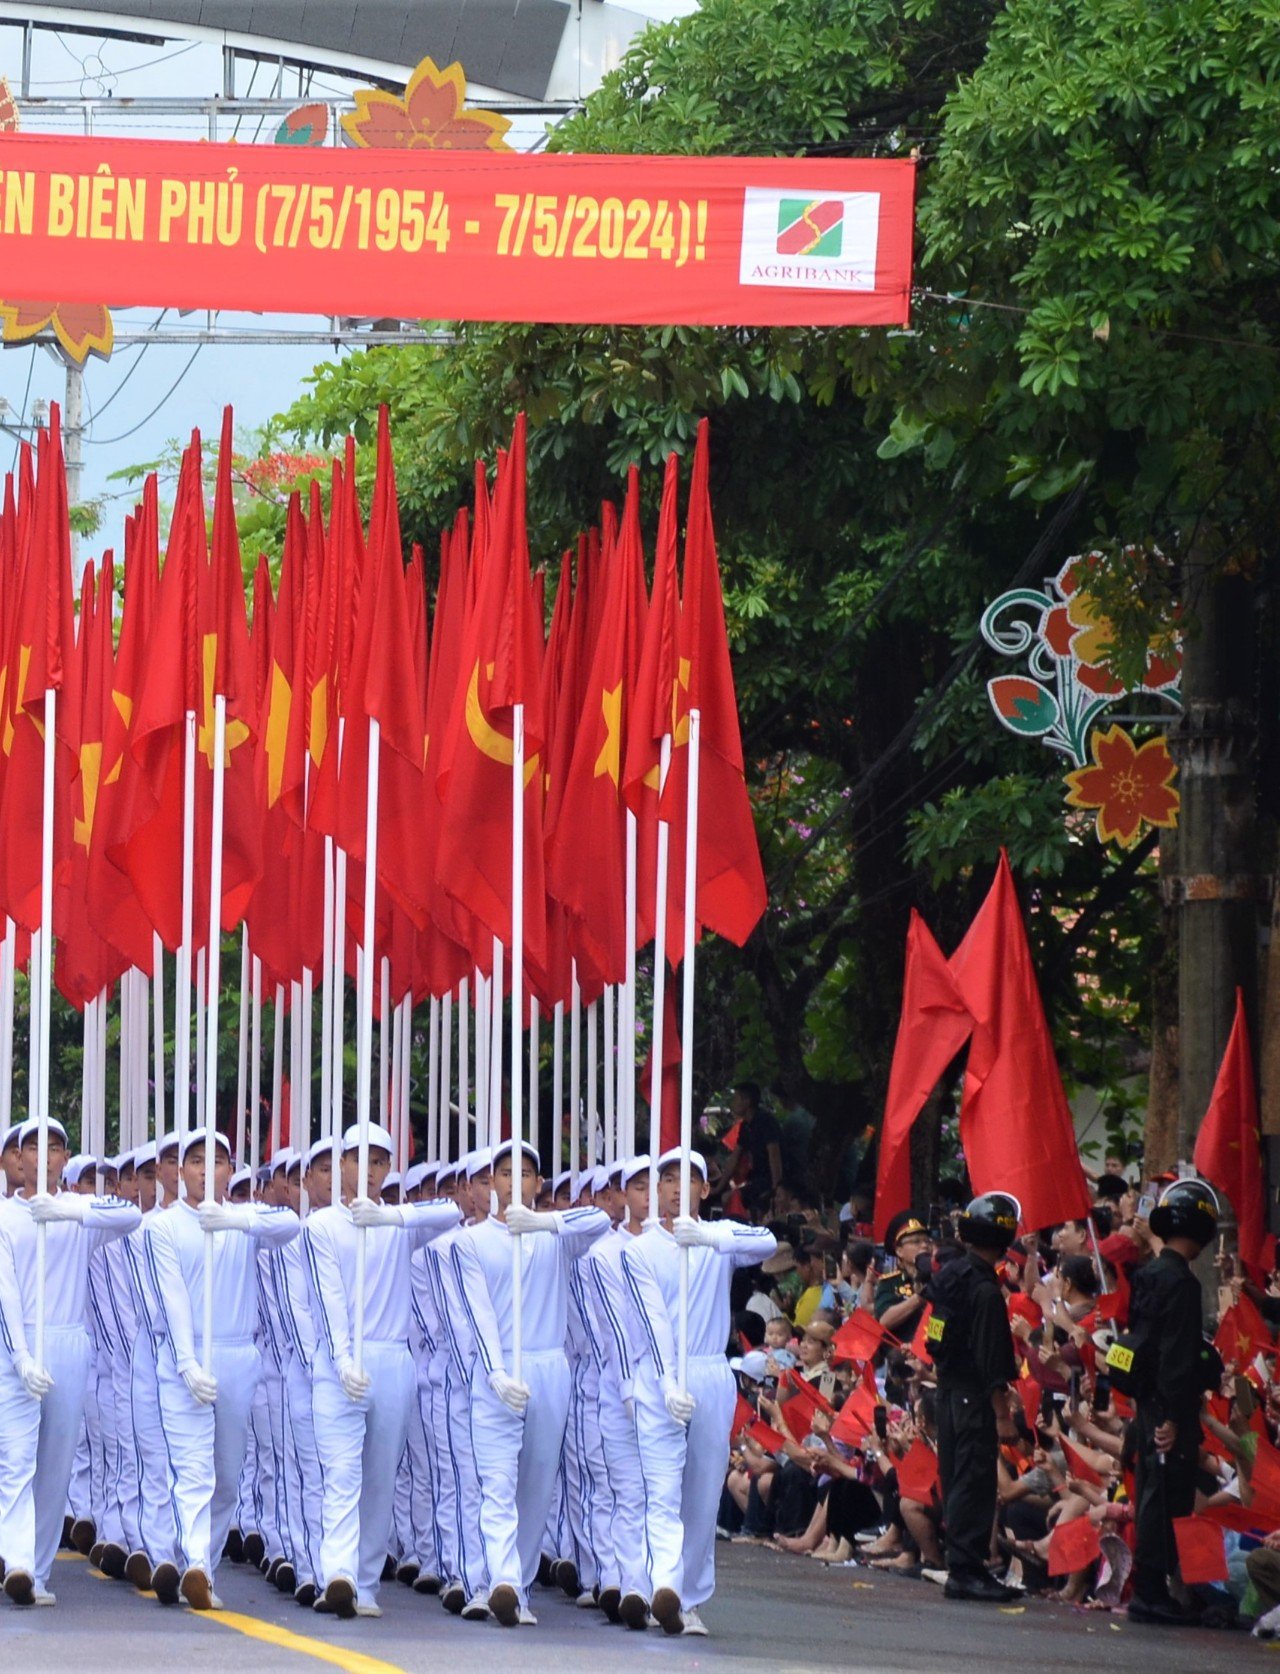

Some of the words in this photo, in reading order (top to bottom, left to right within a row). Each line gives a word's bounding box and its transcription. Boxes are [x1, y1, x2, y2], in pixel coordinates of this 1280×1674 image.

[48, 163, 147, 242] BIÊN
[159, 166, 243, 247] PHỦ
[255, 183, 451, 254] (7/5/1954
[495, 194, 708, 268] 7/5/2024)!
[751, 265, 862, 282] AGRIBANK
